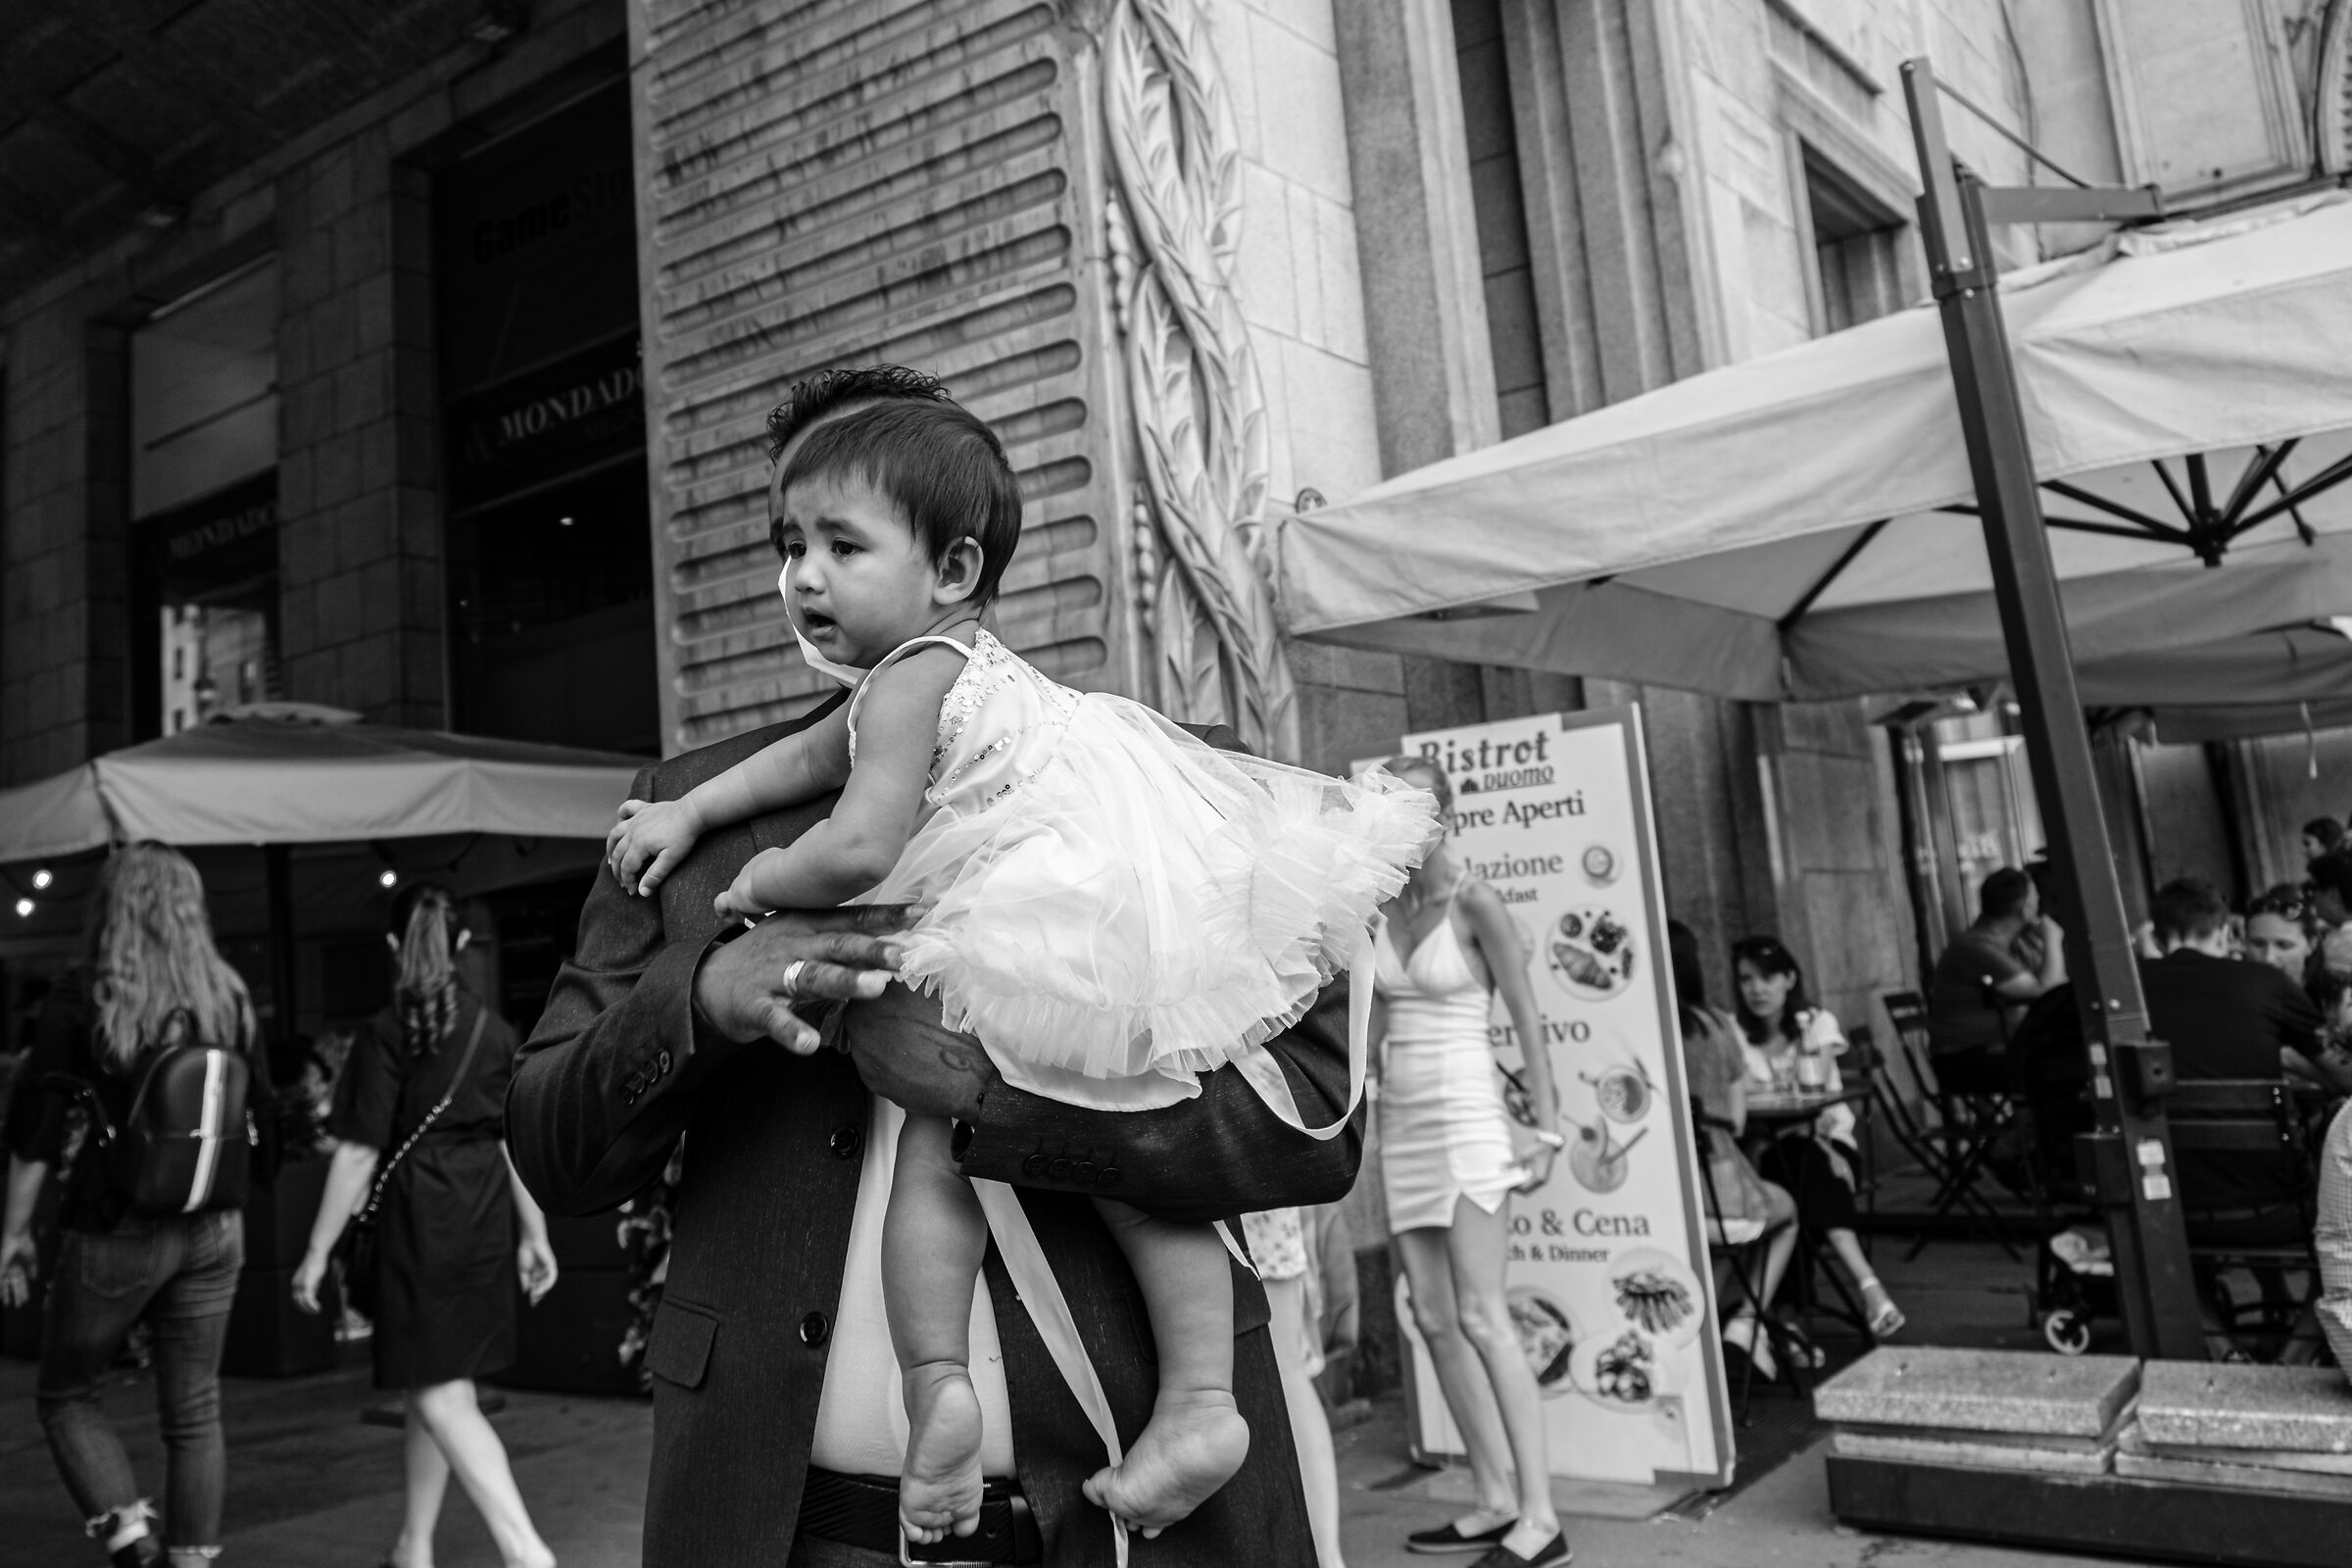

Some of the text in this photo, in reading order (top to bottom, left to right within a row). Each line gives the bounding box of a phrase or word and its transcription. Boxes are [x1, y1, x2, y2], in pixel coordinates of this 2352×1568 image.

[1420, 730, 1550, 774] Bistrot
[1501, 789, 1587, 829] Aperti
[1573, 1206, 1651, 1238] Cena
[1548, 1244, 1610, 1263] Dinner
